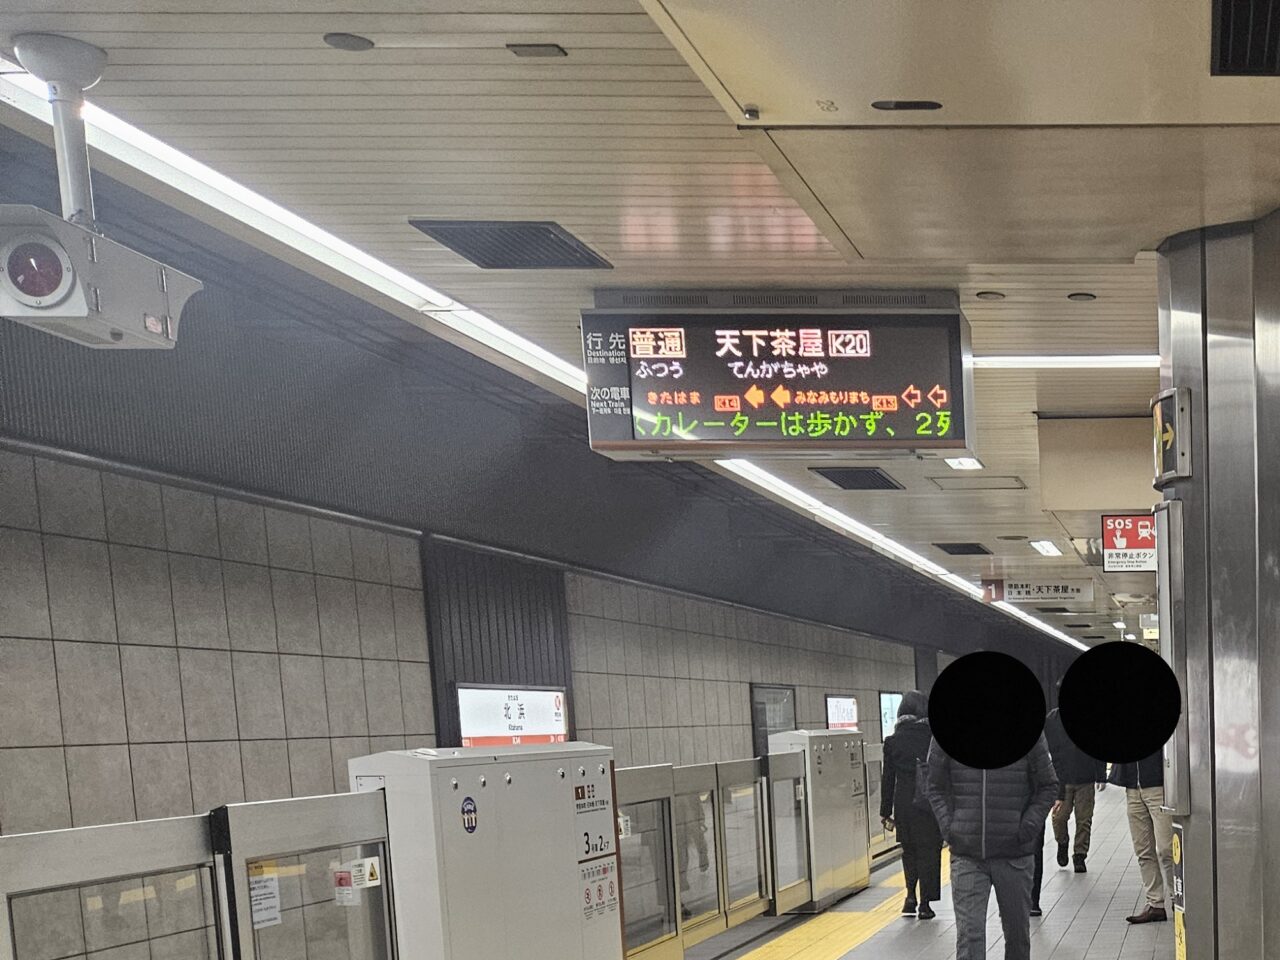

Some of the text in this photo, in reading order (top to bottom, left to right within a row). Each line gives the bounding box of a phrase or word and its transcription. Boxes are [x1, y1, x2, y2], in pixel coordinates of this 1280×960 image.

[587, 332, 626, 350] 行先
[631, 329, 867, 357] 普通 天下茶屋 K20
[635, 361, 829, 378] ふつう てんがちゃや
[590, 386, 630, 400] 次の電車
[647, 390, 701, 405] きたはま
[794, 389, 870, 405] みなみもりまち
[1106, 518, 1133, 529] SOS
[1108, 552, 1154, 560] 非常停止ボタン
[988, 583, 996, 599] 1
